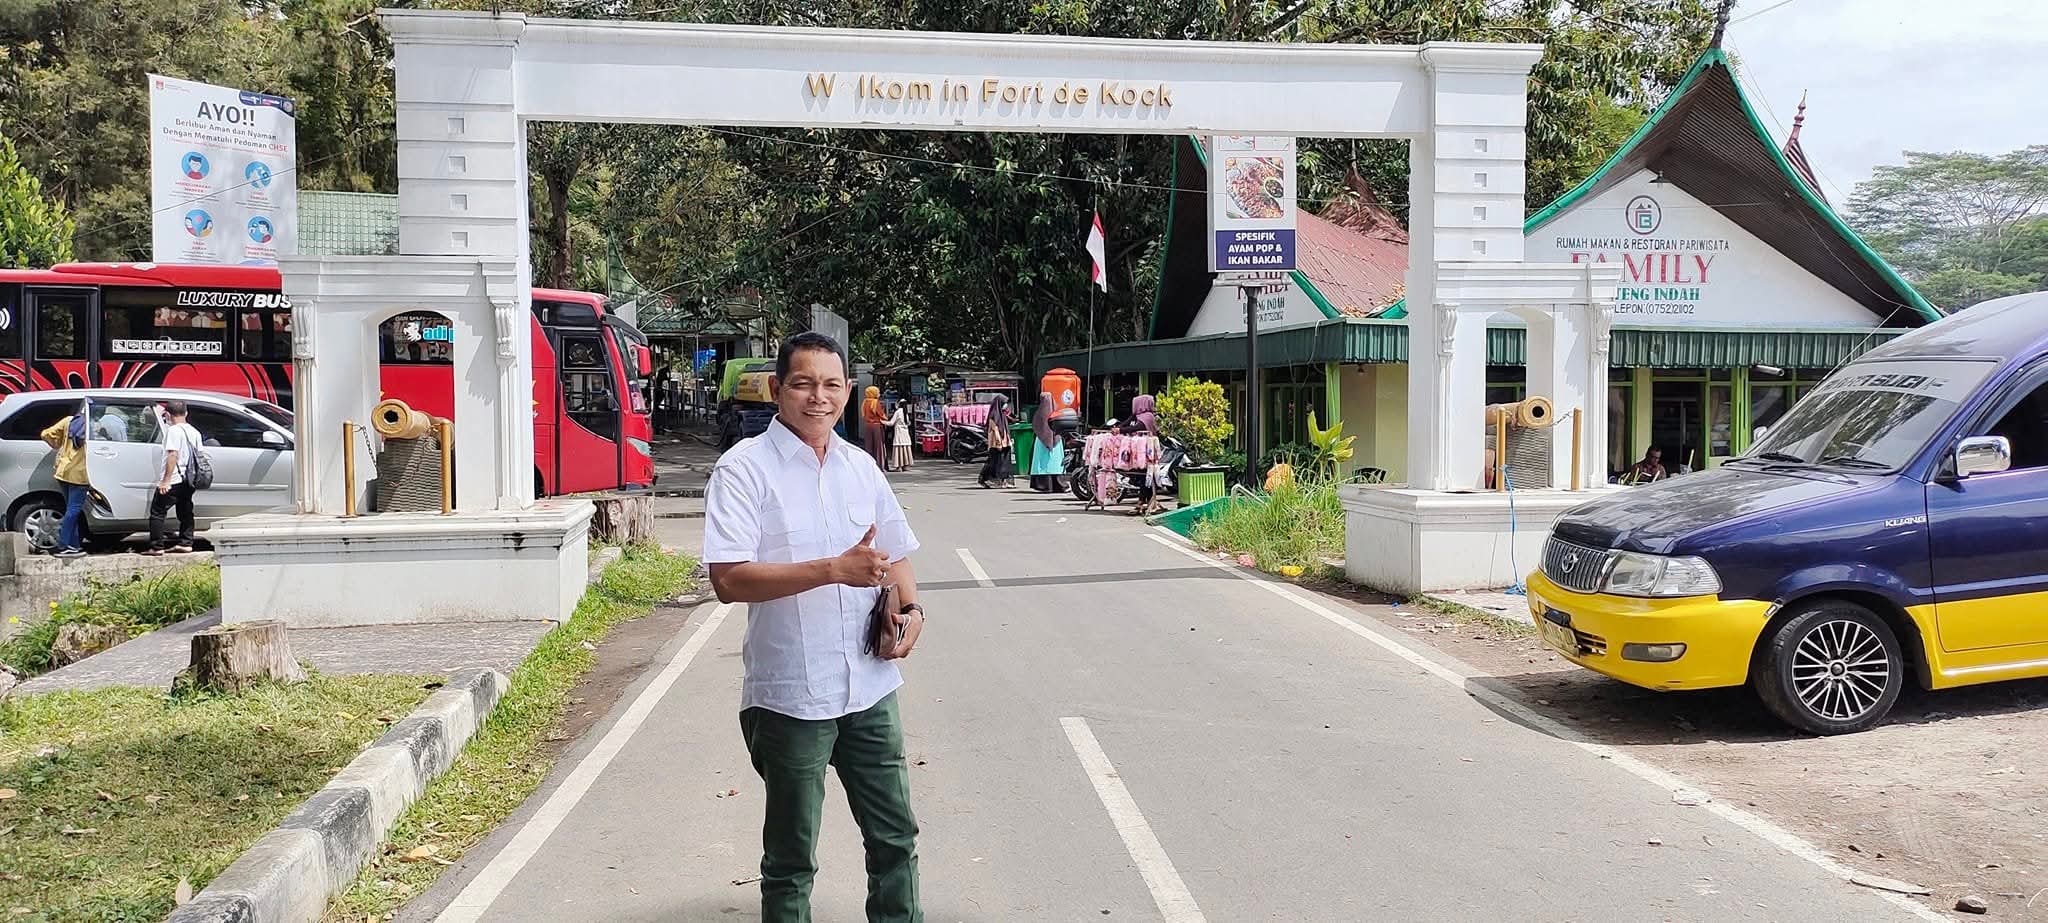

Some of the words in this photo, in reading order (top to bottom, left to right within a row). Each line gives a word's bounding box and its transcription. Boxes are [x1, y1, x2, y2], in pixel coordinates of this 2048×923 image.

[807, 73, 932, 100] Wlkom
[944, 78, 970, 102] in
[983, 78, 1043, 103] Fort
[1054, 81, 1089, 105] de
[1101, 81, 1174, 107] Kock
[197, 101, 255, 127] AYO!!
[175, 118, 207, 130] Berlibur
[209, 124, 231, 134] Aman
[232, 126, 246, 136] dan
[247, 130, 277, 141] Nyaman
[163, 127, 193, 139] Dengan
[194, 132, 233, 144] Mematuhi
[234, 138, 268, 150] Pedoman
[268, 143, 289, 153] CHSE
[1235, 232, 1276, 241] SPESIFIK
[1556, 237, 1588, 250] RUMAH
[1590, 238, 1622, 250] MAKAN
[1623, 239, 1630, 250] &
[1631, 239, 1677, 251] RESTORAN
[1679, 239, 1729, 252] PARIWISATA
[1228, 243, 1254, 253] AYAM
[1255, 243, 1275, 253] POP
[1275, 243, 1283, 252] &
[1228, 256, 1252, 265] IKAN
[1252, 255, 1283, 265] BAKAR
[177, 291, 254, 308] LUXURY
[252, 293, 292, 309] BUS
[1654, 287, 1700, 301] INDAH
